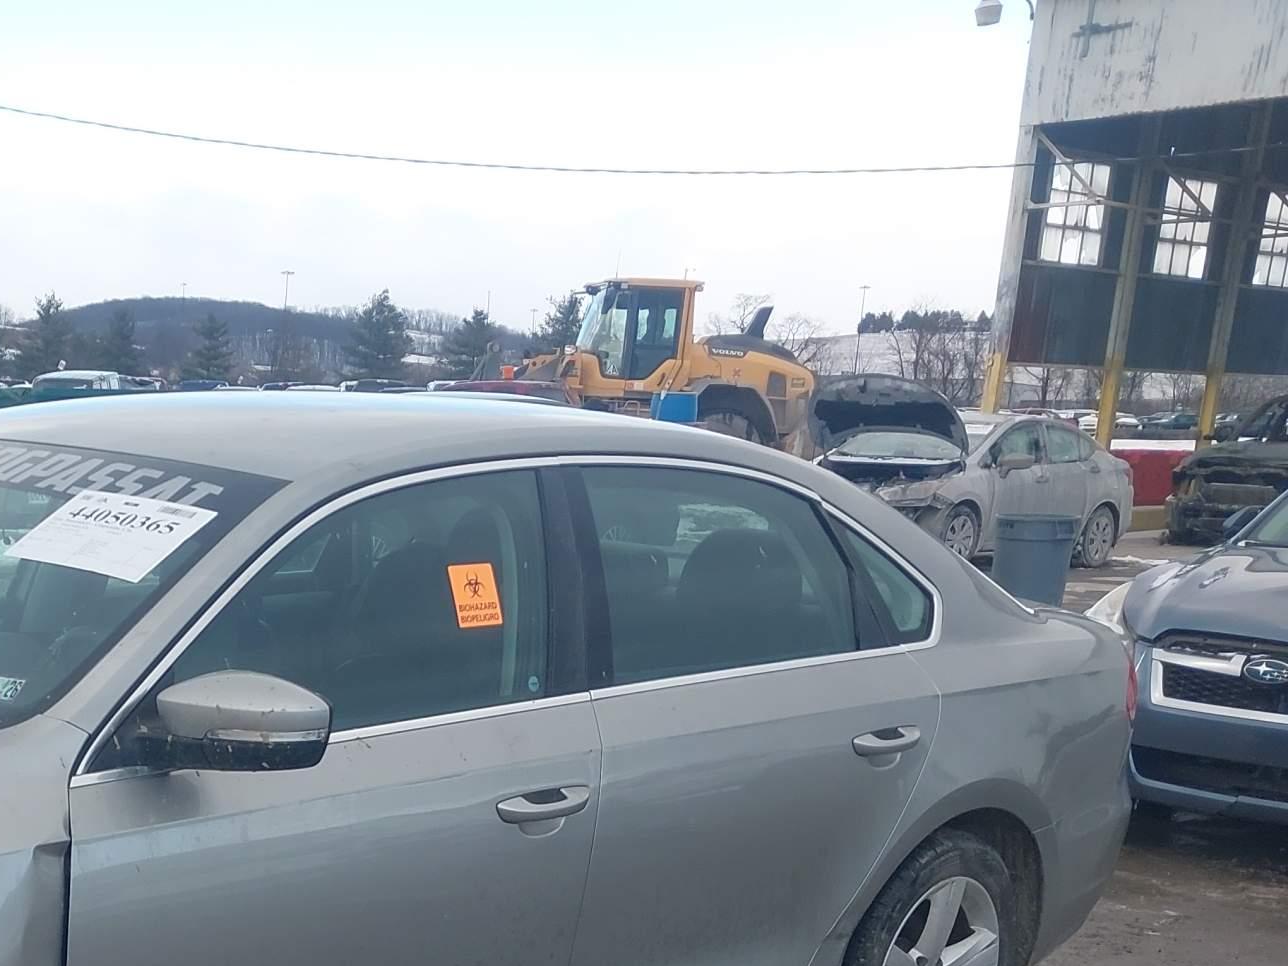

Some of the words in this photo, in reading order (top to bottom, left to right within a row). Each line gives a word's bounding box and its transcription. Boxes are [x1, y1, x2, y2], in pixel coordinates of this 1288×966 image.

[712, 348, 744, 357] VOLVO
[68, 505, 182, 536] 44050365
[458, 601, 498, 612] BIOHAZARD
[459, 612, 500, 624] BIOPELIGRO
